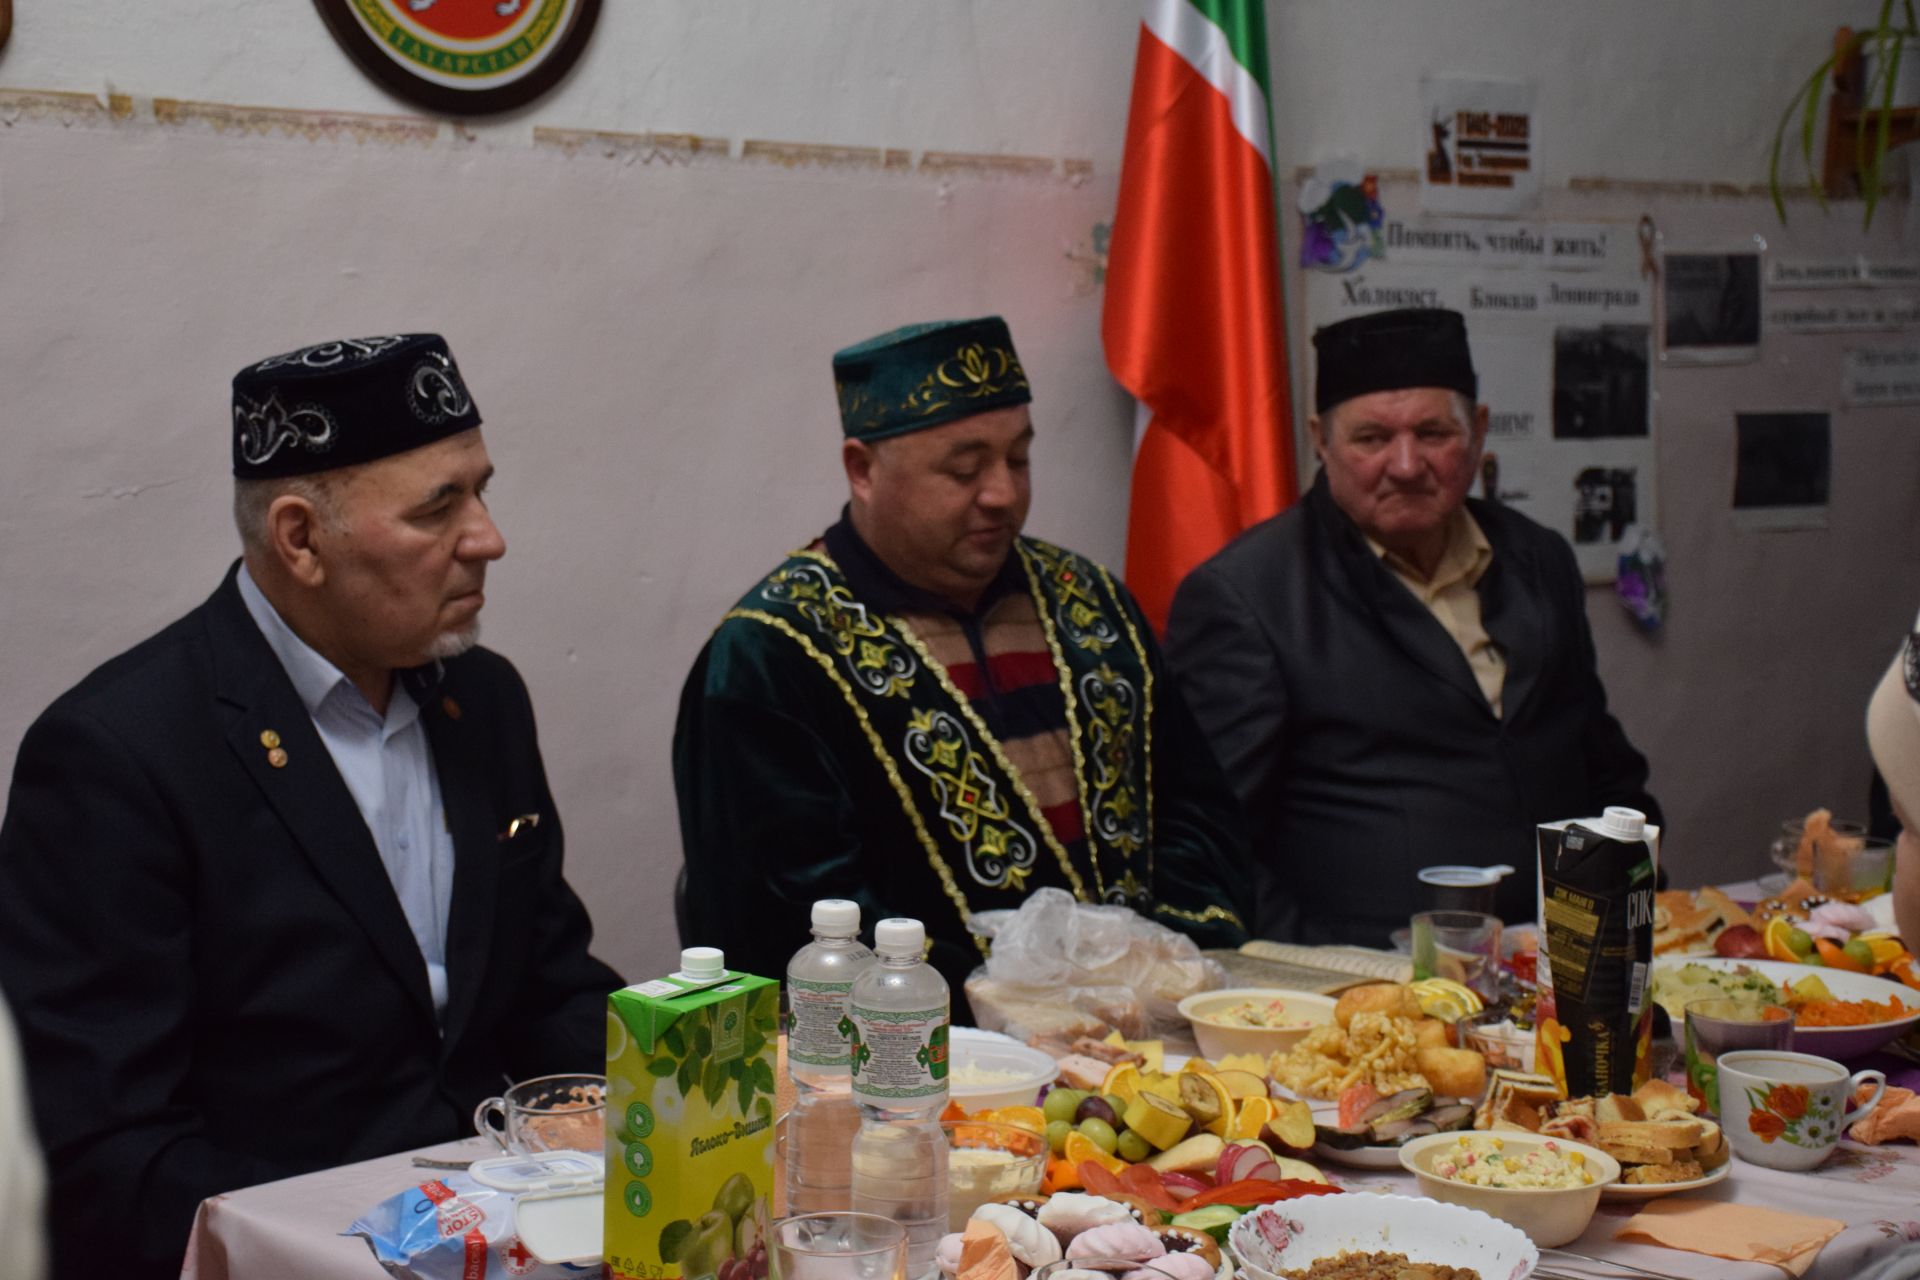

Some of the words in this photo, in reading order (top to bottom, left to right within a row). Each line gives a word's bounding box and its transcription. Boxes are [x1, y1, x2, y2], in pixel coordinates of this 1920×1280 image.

[1387, 221, 1481, 254] Помнить,
[1485, 229, 1545, 255] чтобы
[1552, 233, 1606, 258] жить!
[445, 1209, 478, 1237] STOP
